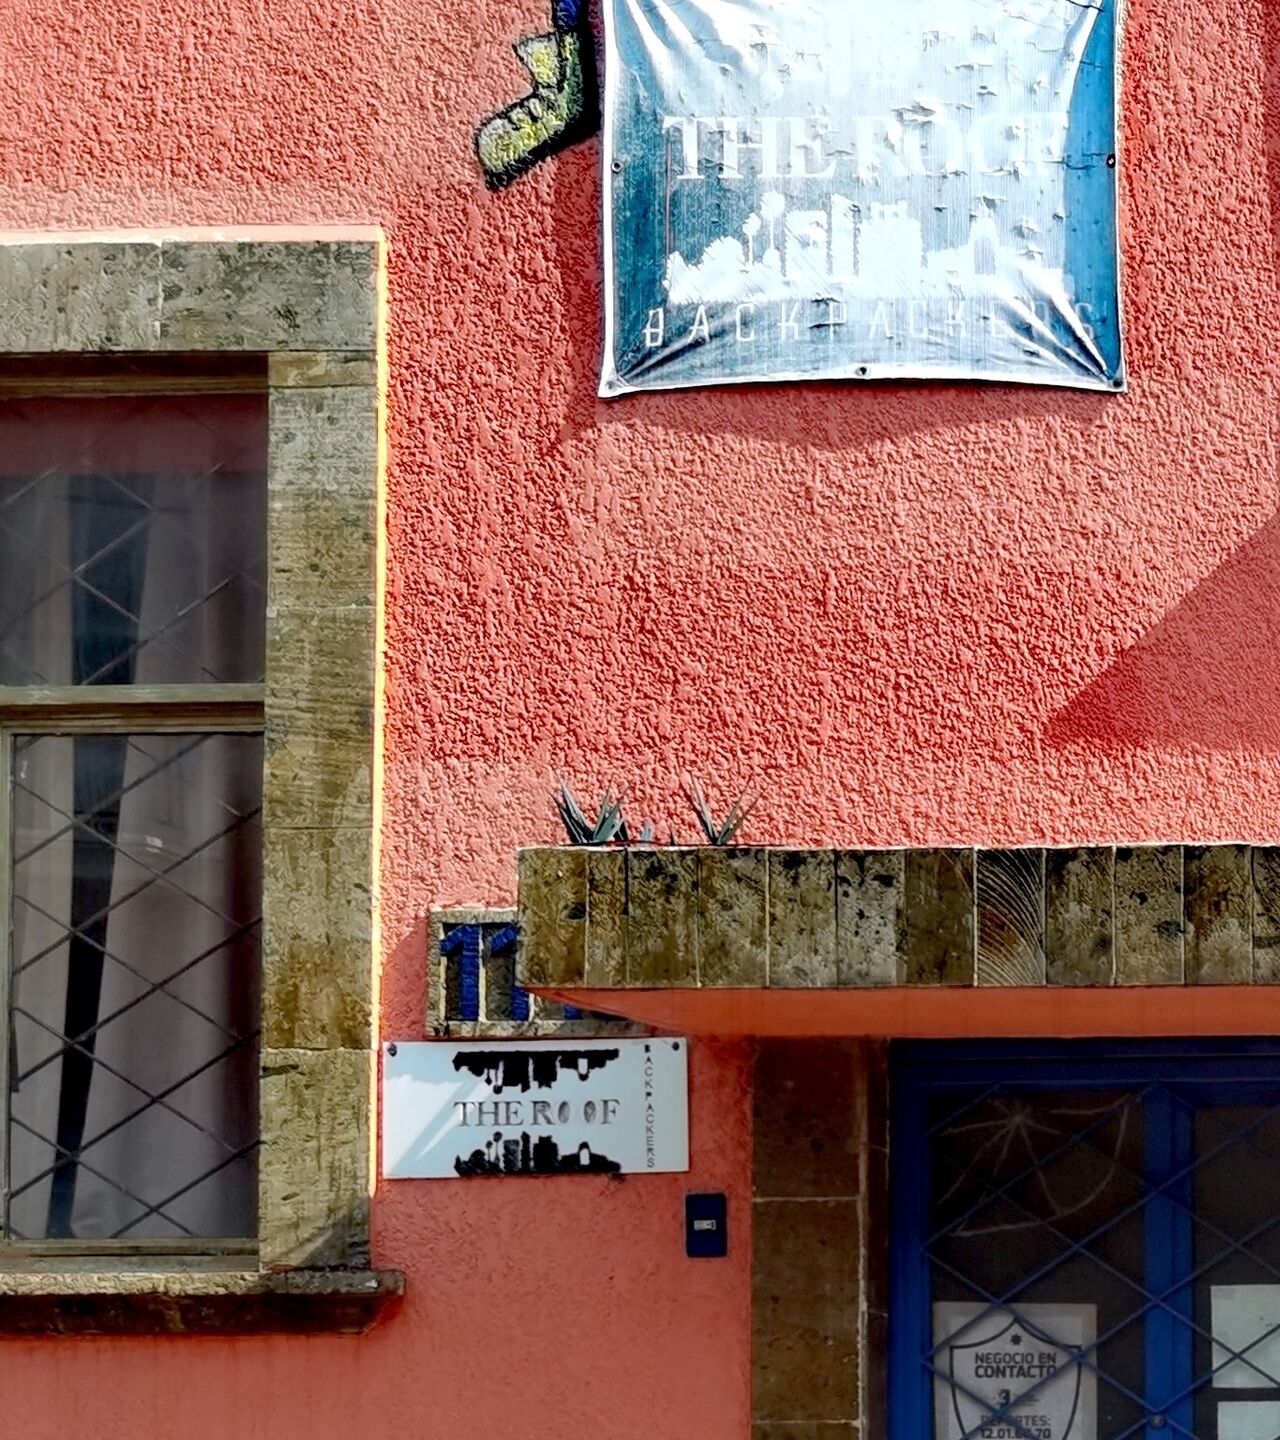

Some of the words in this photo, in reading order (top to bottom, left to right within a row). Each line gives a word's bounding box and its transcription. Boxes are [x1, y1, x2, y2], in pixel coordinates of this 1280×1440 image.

[453, 1099, 525, 1127] THE
[644, 1043, 656, 1169] BACKPACKERS
[975, 1353, 1034, 1364] NEGOCIO
[1038, 1353, 1056, 1364] EN
[975, 1365, 1057, 1378] CONTACTO
